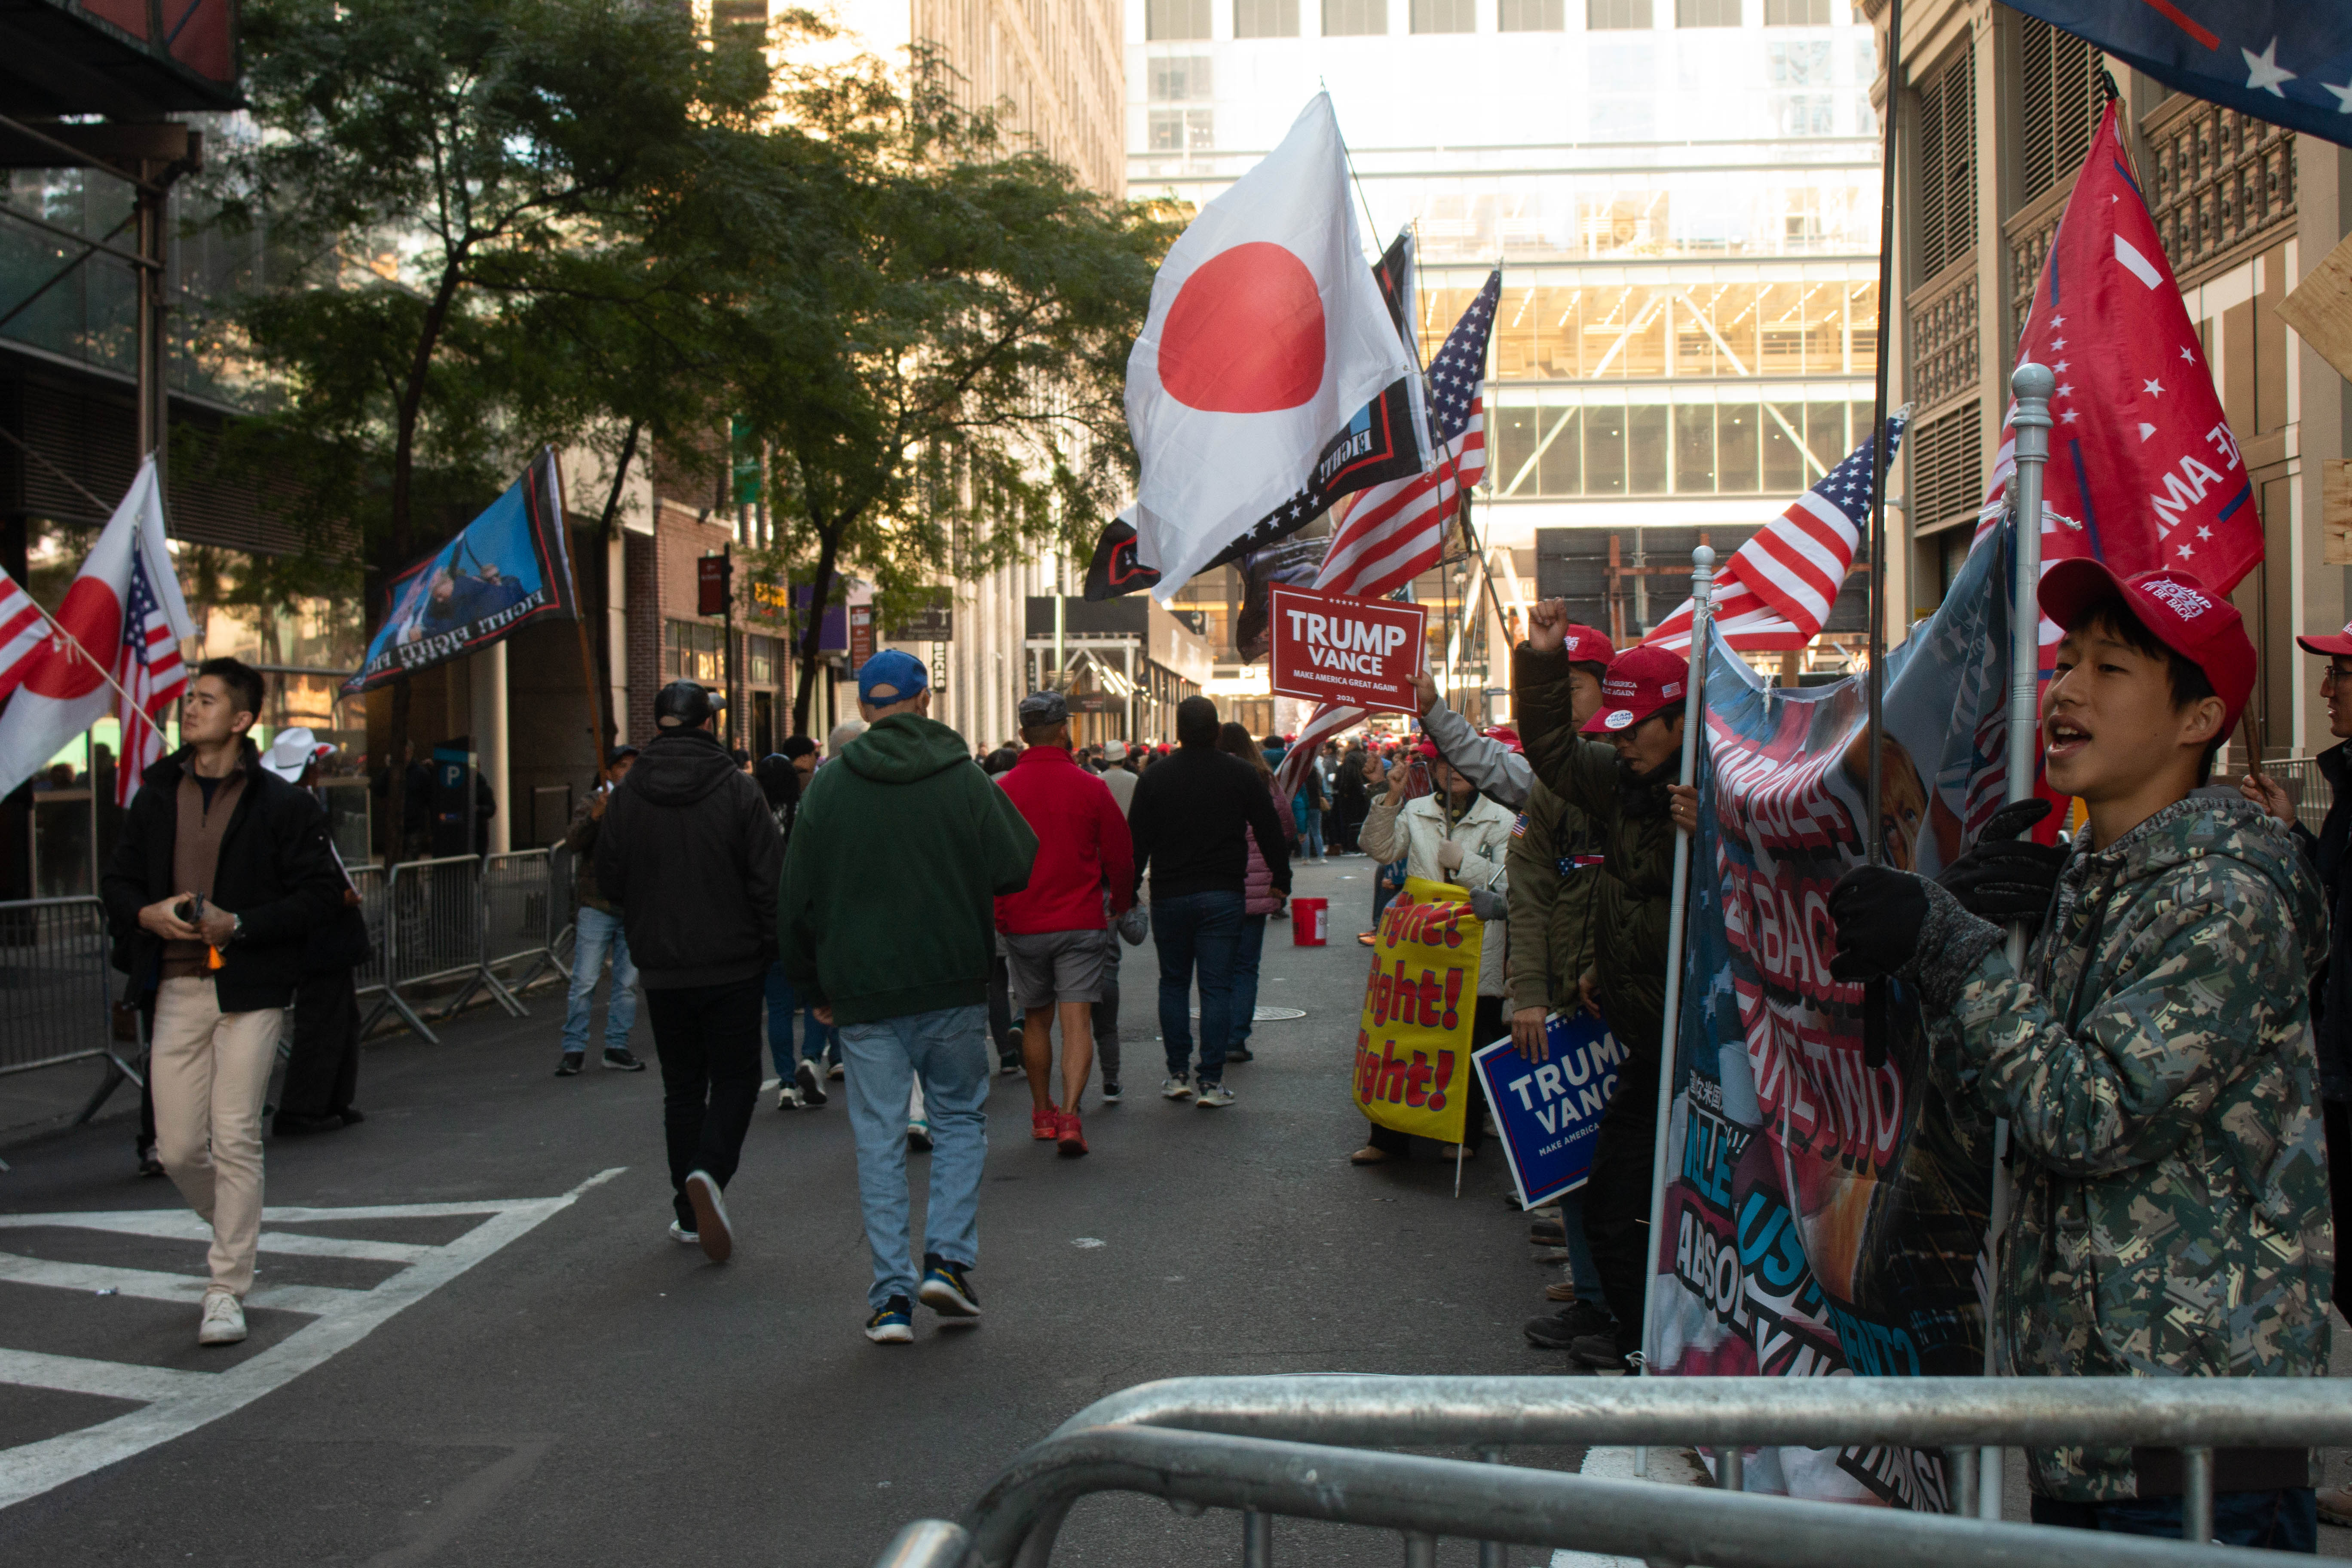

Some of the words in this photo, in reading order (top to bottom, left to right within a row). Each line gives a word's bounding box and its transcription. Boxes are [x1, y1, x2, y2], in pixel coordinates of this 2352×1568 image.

[2152, 588, 2169, 600] BE
[2166, 598, 2194, 622] BACK
[2162, 576, 2212, 609] TRUMP
[1286, 609, 1406, 656] TRUMP
[933, 641, 945, 688] BUCKS
[1308, 645, 1383, 677] VANCE
[1293, 669, 1314, 679] MAKE
[1315, 674, 1348, 685] AMERICA
[1348, 678, 1372, 688] GREAT
[1372, 683, 1398, 692] AGAIN!
[1336, 694, 1356, 704] 2024
[447, 766, 460, 785] P
[1752, 882, 1833, 987] BAC
[1535, 1074, 1618, 1135] VANC
[1802, 1040, 1900, 1152] TWO
[1539, 1142, 1563, 1157] MAKE
[1564, 1121, 1600, 1145] AMERICA
